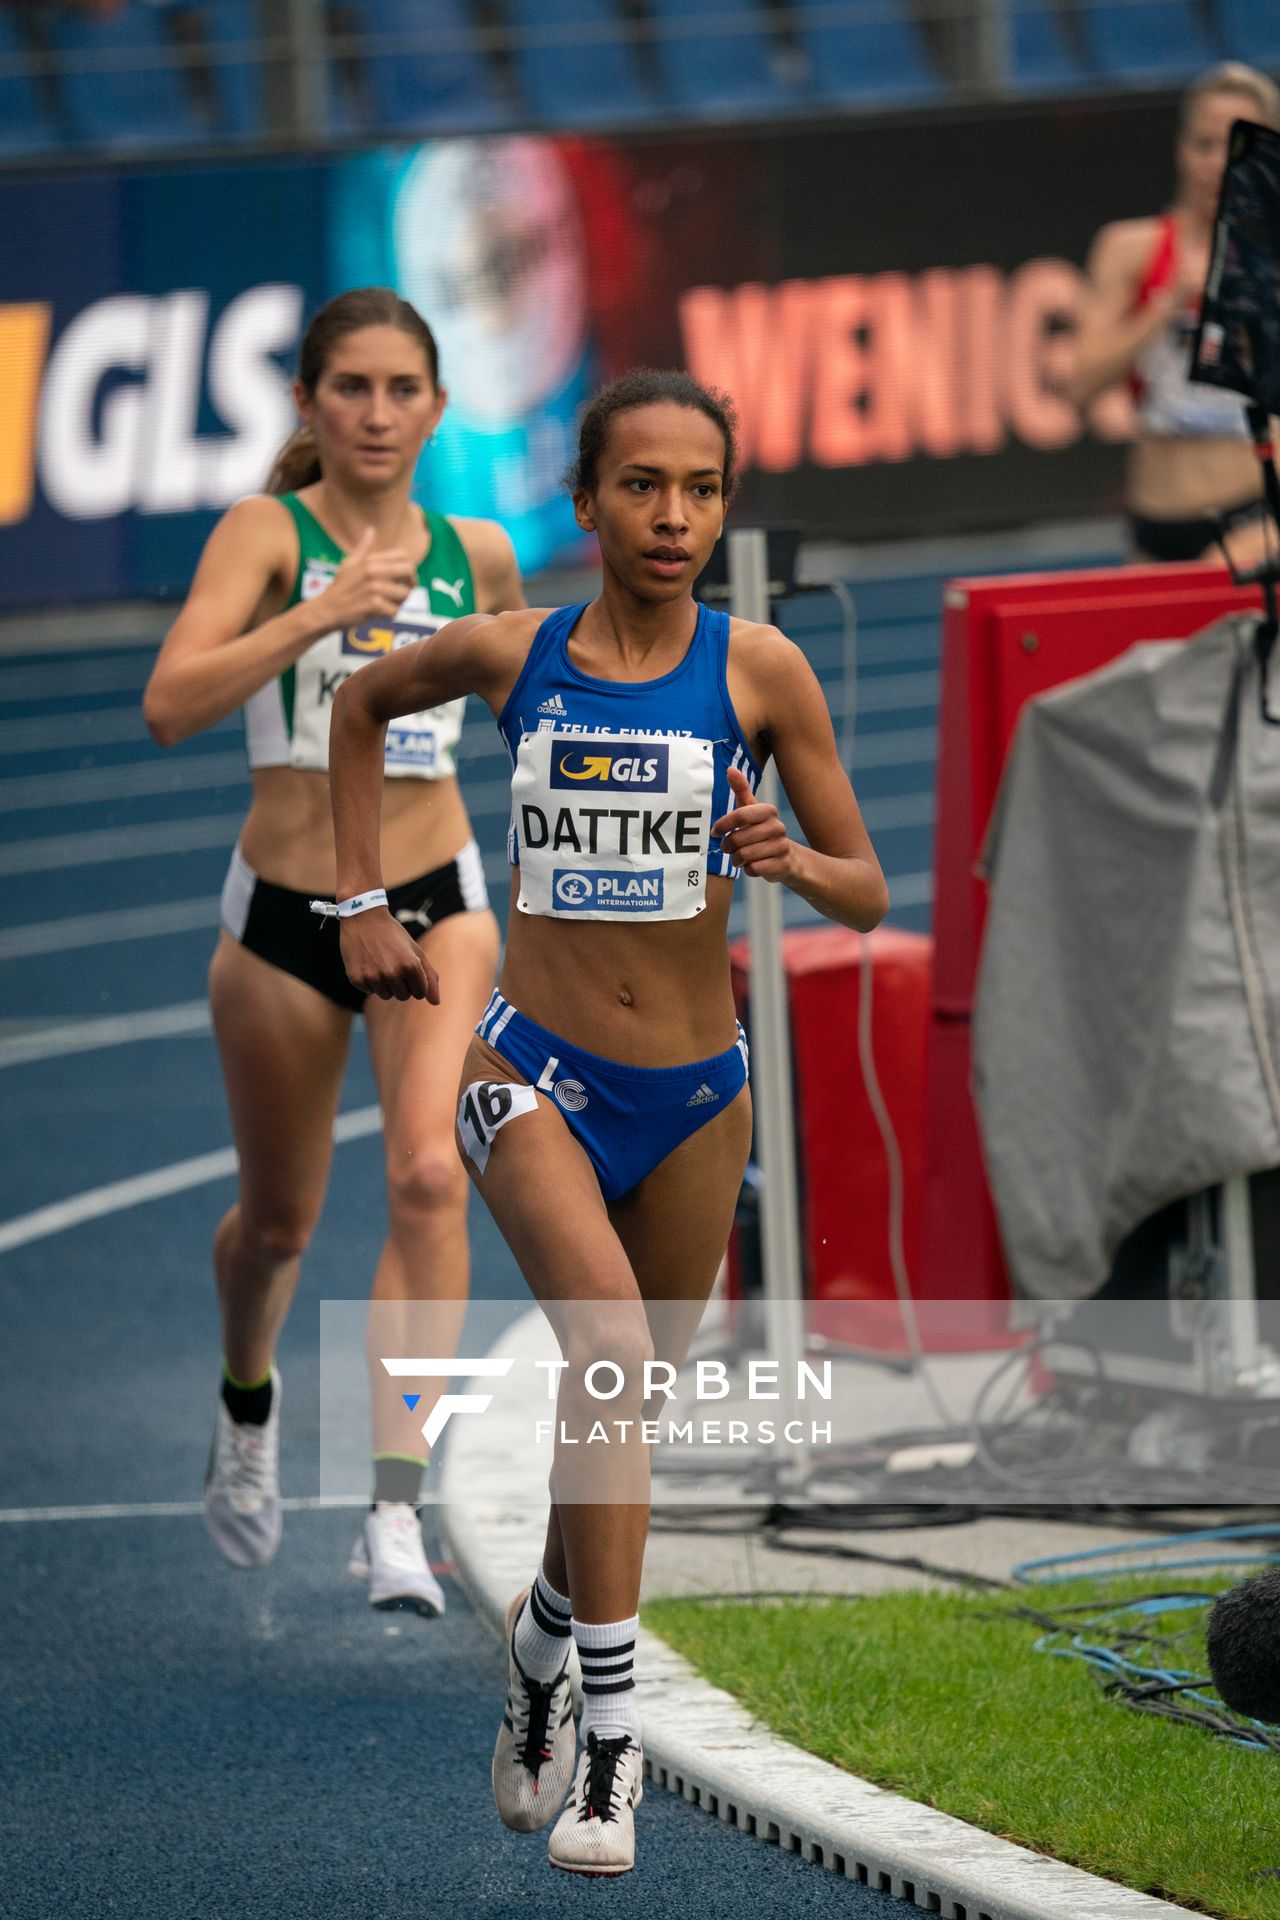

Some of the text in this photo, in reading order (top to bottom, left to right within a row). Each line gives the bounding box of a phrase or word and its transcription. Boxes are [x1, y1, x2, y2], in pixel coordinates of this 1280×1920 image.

[40, 282, 304, 521] GLS
[537, 706, 567, 717] adidas
[611, 757, 658, 783] GLS
[521, 804, 702, 855] DATTKE
[597, 876, 659, 897] PLAN
[597, 899, 658, 907] INTERNATIONAL
[686, 1092, 720, 1108] adidas
[464, 1081, 512, 1147] 16
